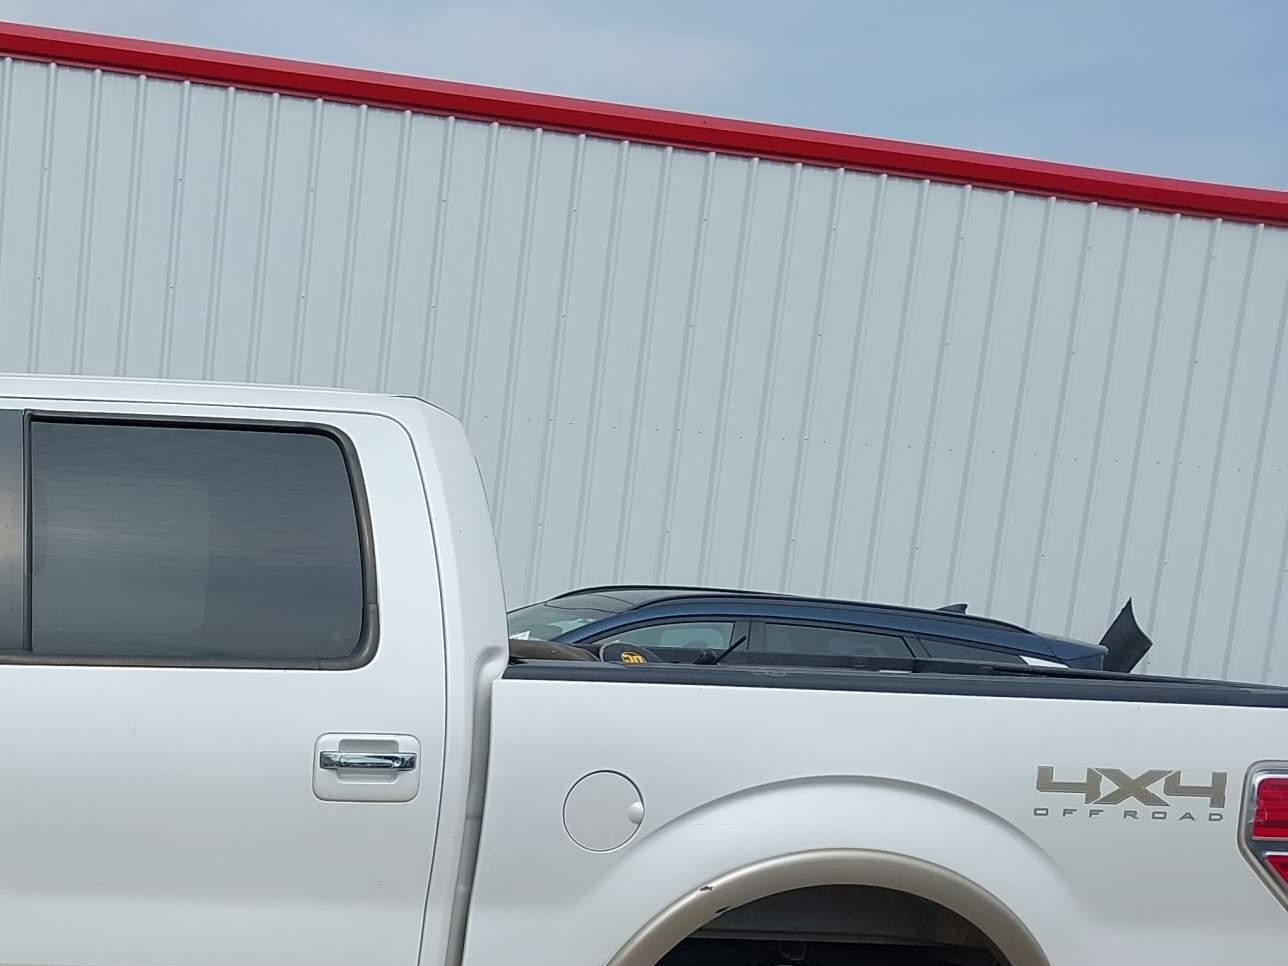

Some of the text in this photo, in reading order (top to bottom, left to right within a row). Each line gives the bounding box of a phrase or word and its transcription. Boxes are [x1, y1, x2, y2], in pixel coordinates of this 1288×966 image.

[1036, 765, 1227, 808] 4X4
[1033, 807, 1224, 822] OFF ROAD
